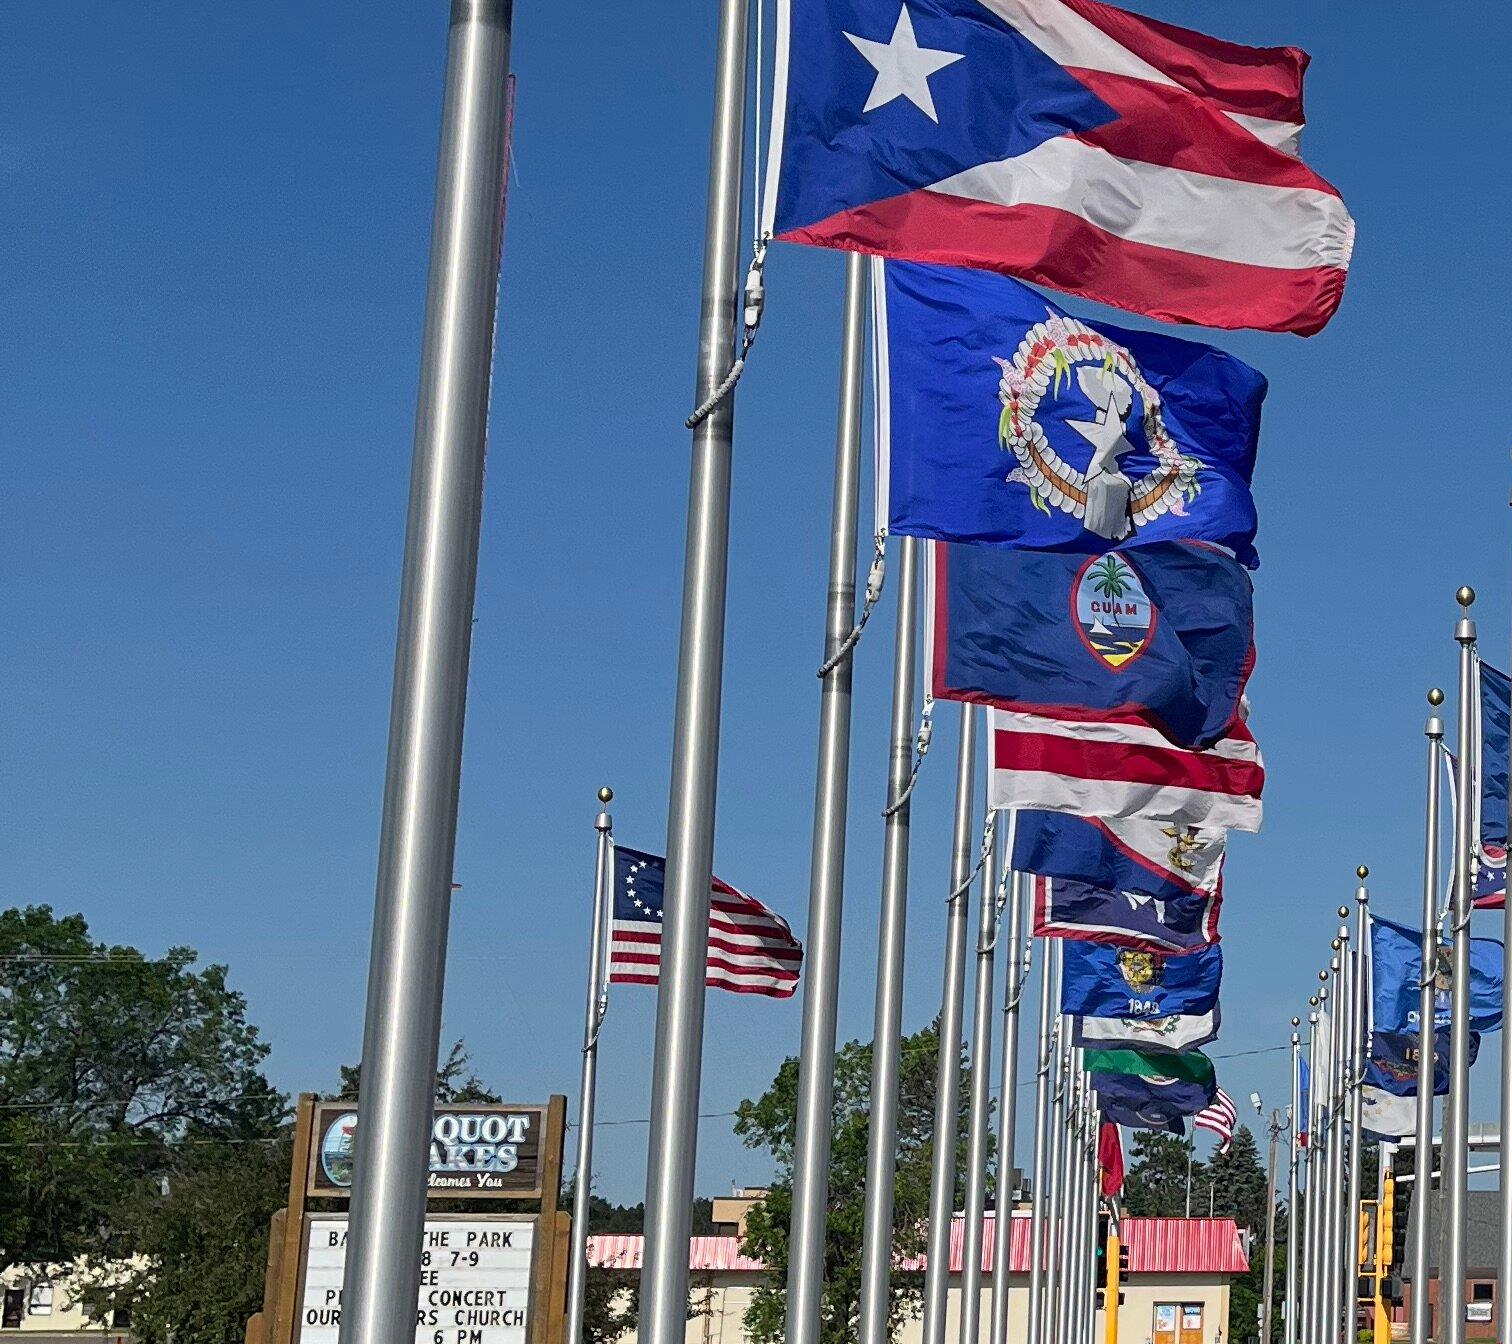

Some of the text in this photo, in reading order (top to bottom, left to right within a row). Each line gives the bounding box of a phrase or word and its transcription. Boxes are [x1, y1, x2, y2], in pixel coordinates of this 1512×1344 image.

[1091, 600, 1137, 615] GUAM
[433, 1114, 530, 1146] QUOT
[428, 1144, 518, 1172] AKES
[477, 1173, 502, 1187] You
[467, 1232, 513, 1247] PARK
[451, 1252, 479, 1267] 7-9
[420, 1271, 438, 1285] EE
[429, 1291, 506, 1306] CONCERT
[306, 1309, 341, 1325] OUR
[455, 1310, 524, 1326] CHURCH
[434, 1330, 482, 1344] 6 PM
